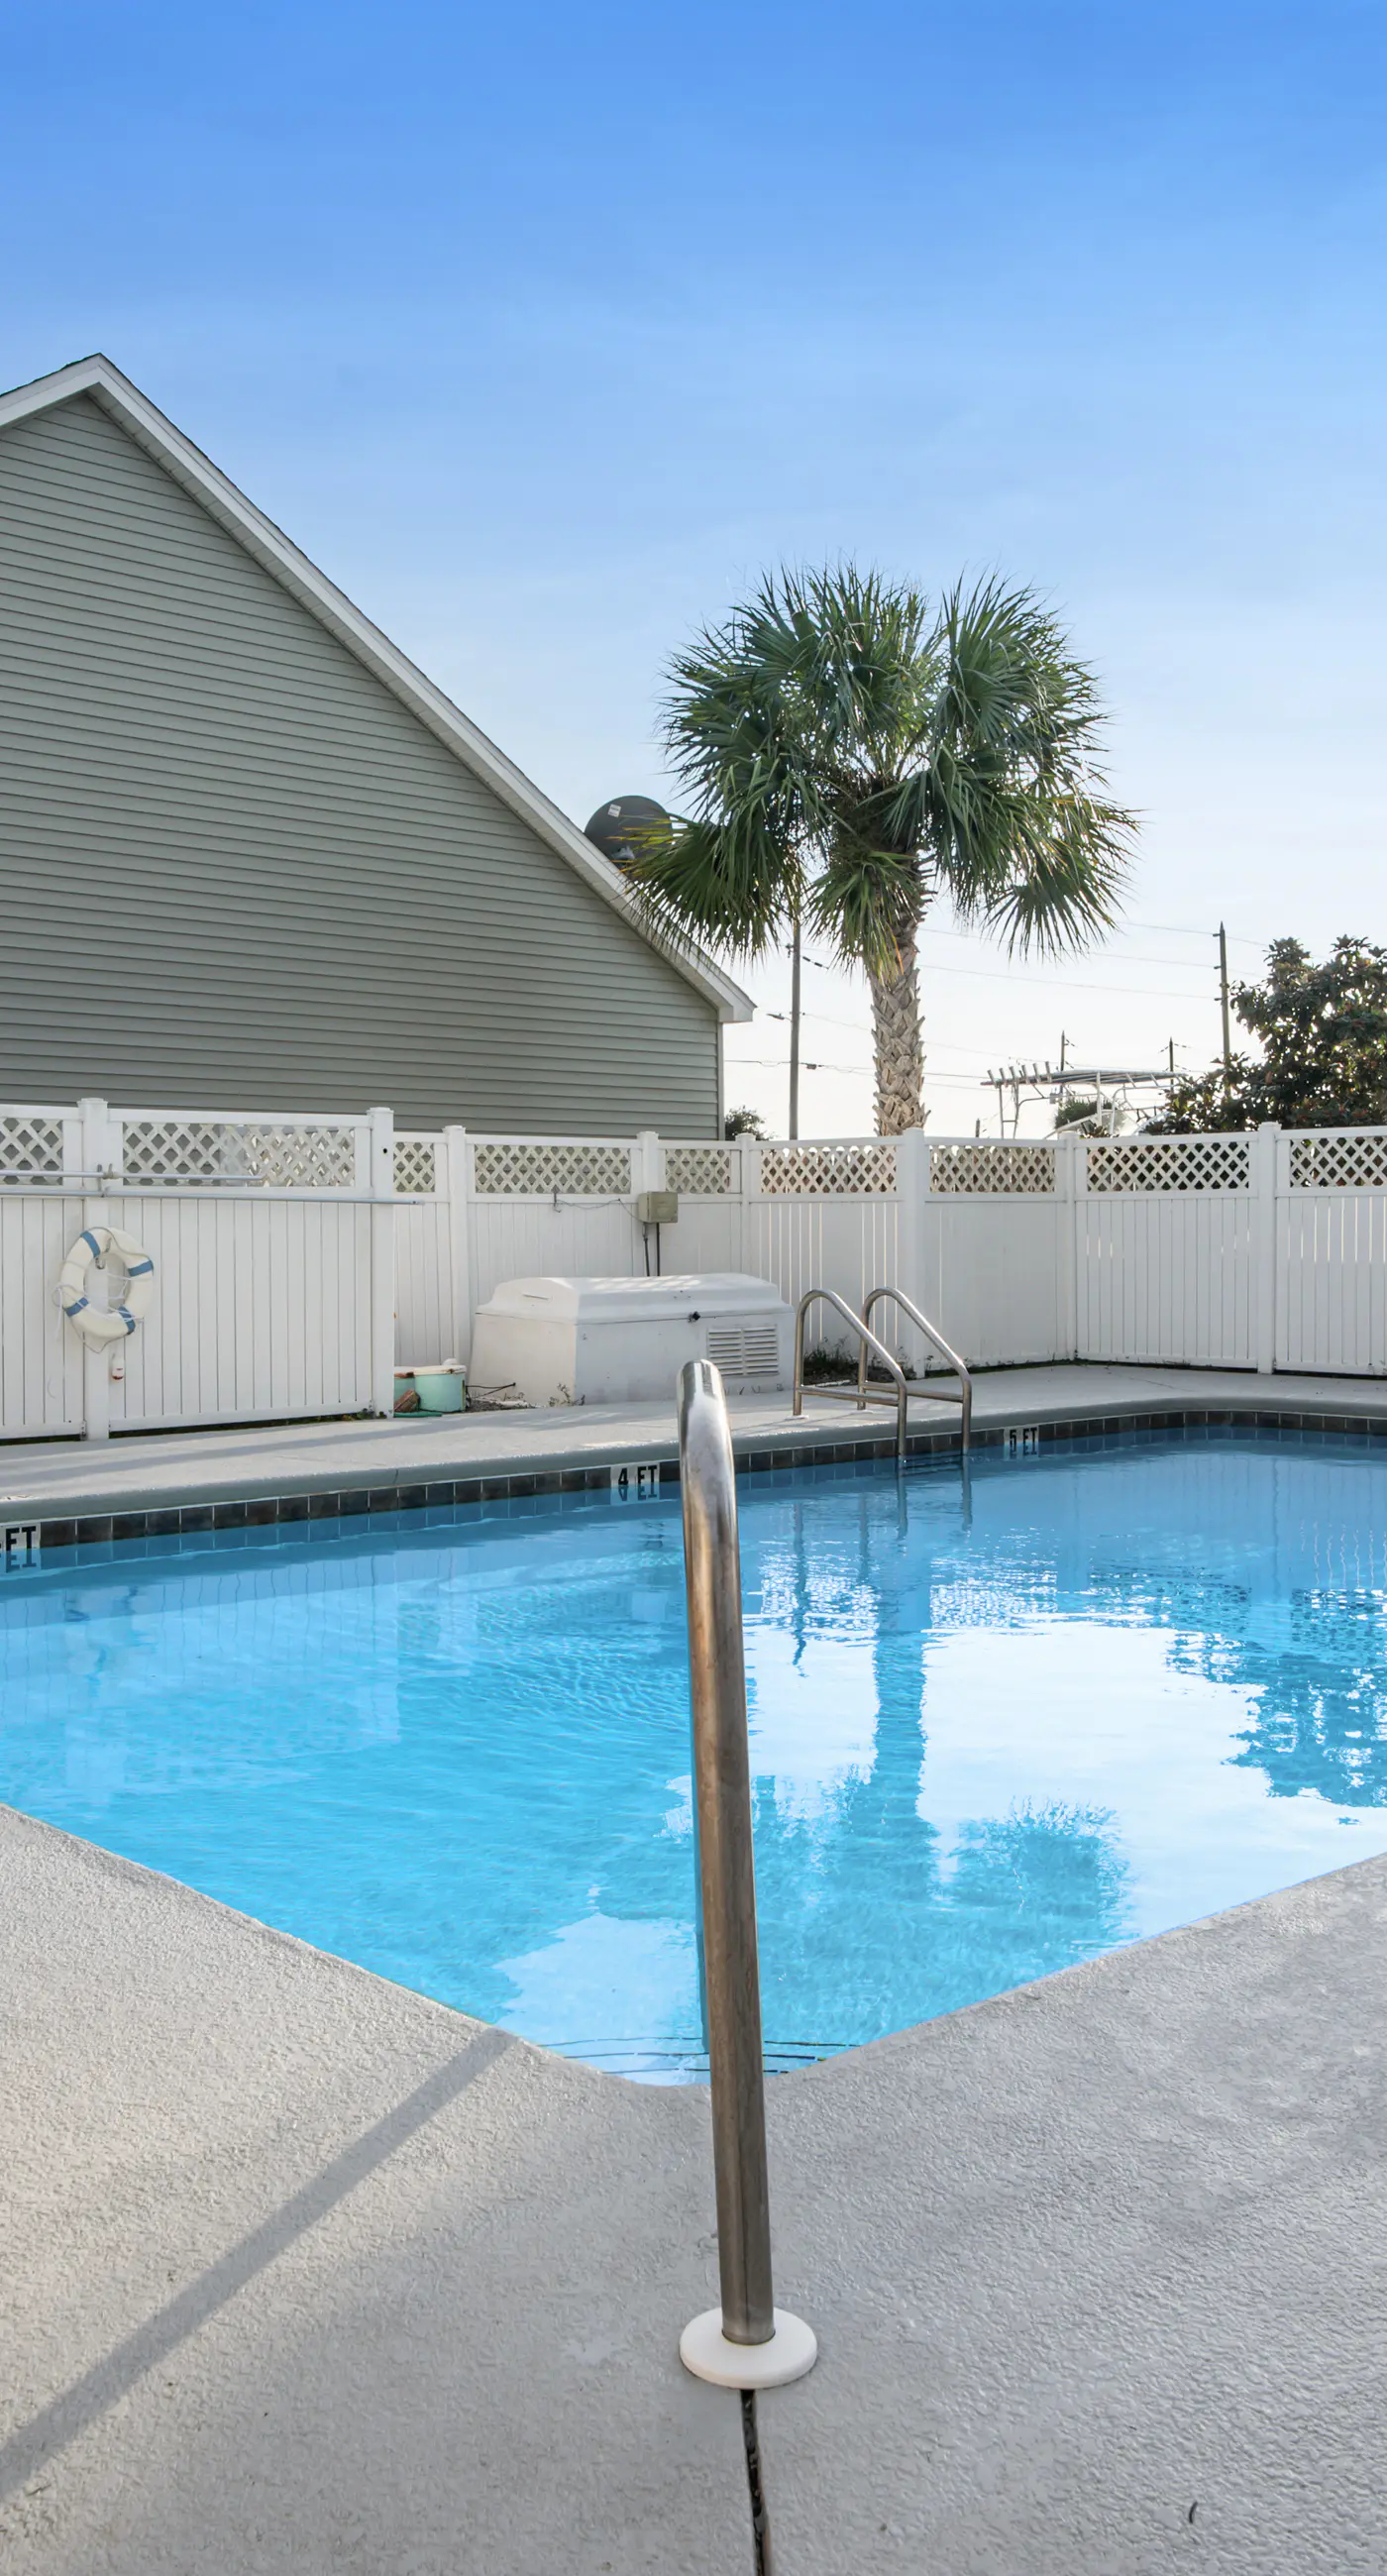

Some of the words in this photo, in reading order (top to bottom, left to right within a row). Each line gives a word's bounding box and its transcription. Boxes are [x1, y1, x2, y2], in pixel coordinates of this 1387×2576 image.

[1022, 1427, 1037, 1444] FT
[618, 1467, 628, 1485] 4
[637, 1465, 657, 1484] FT
[6, 1526, 37, 1551] FT
